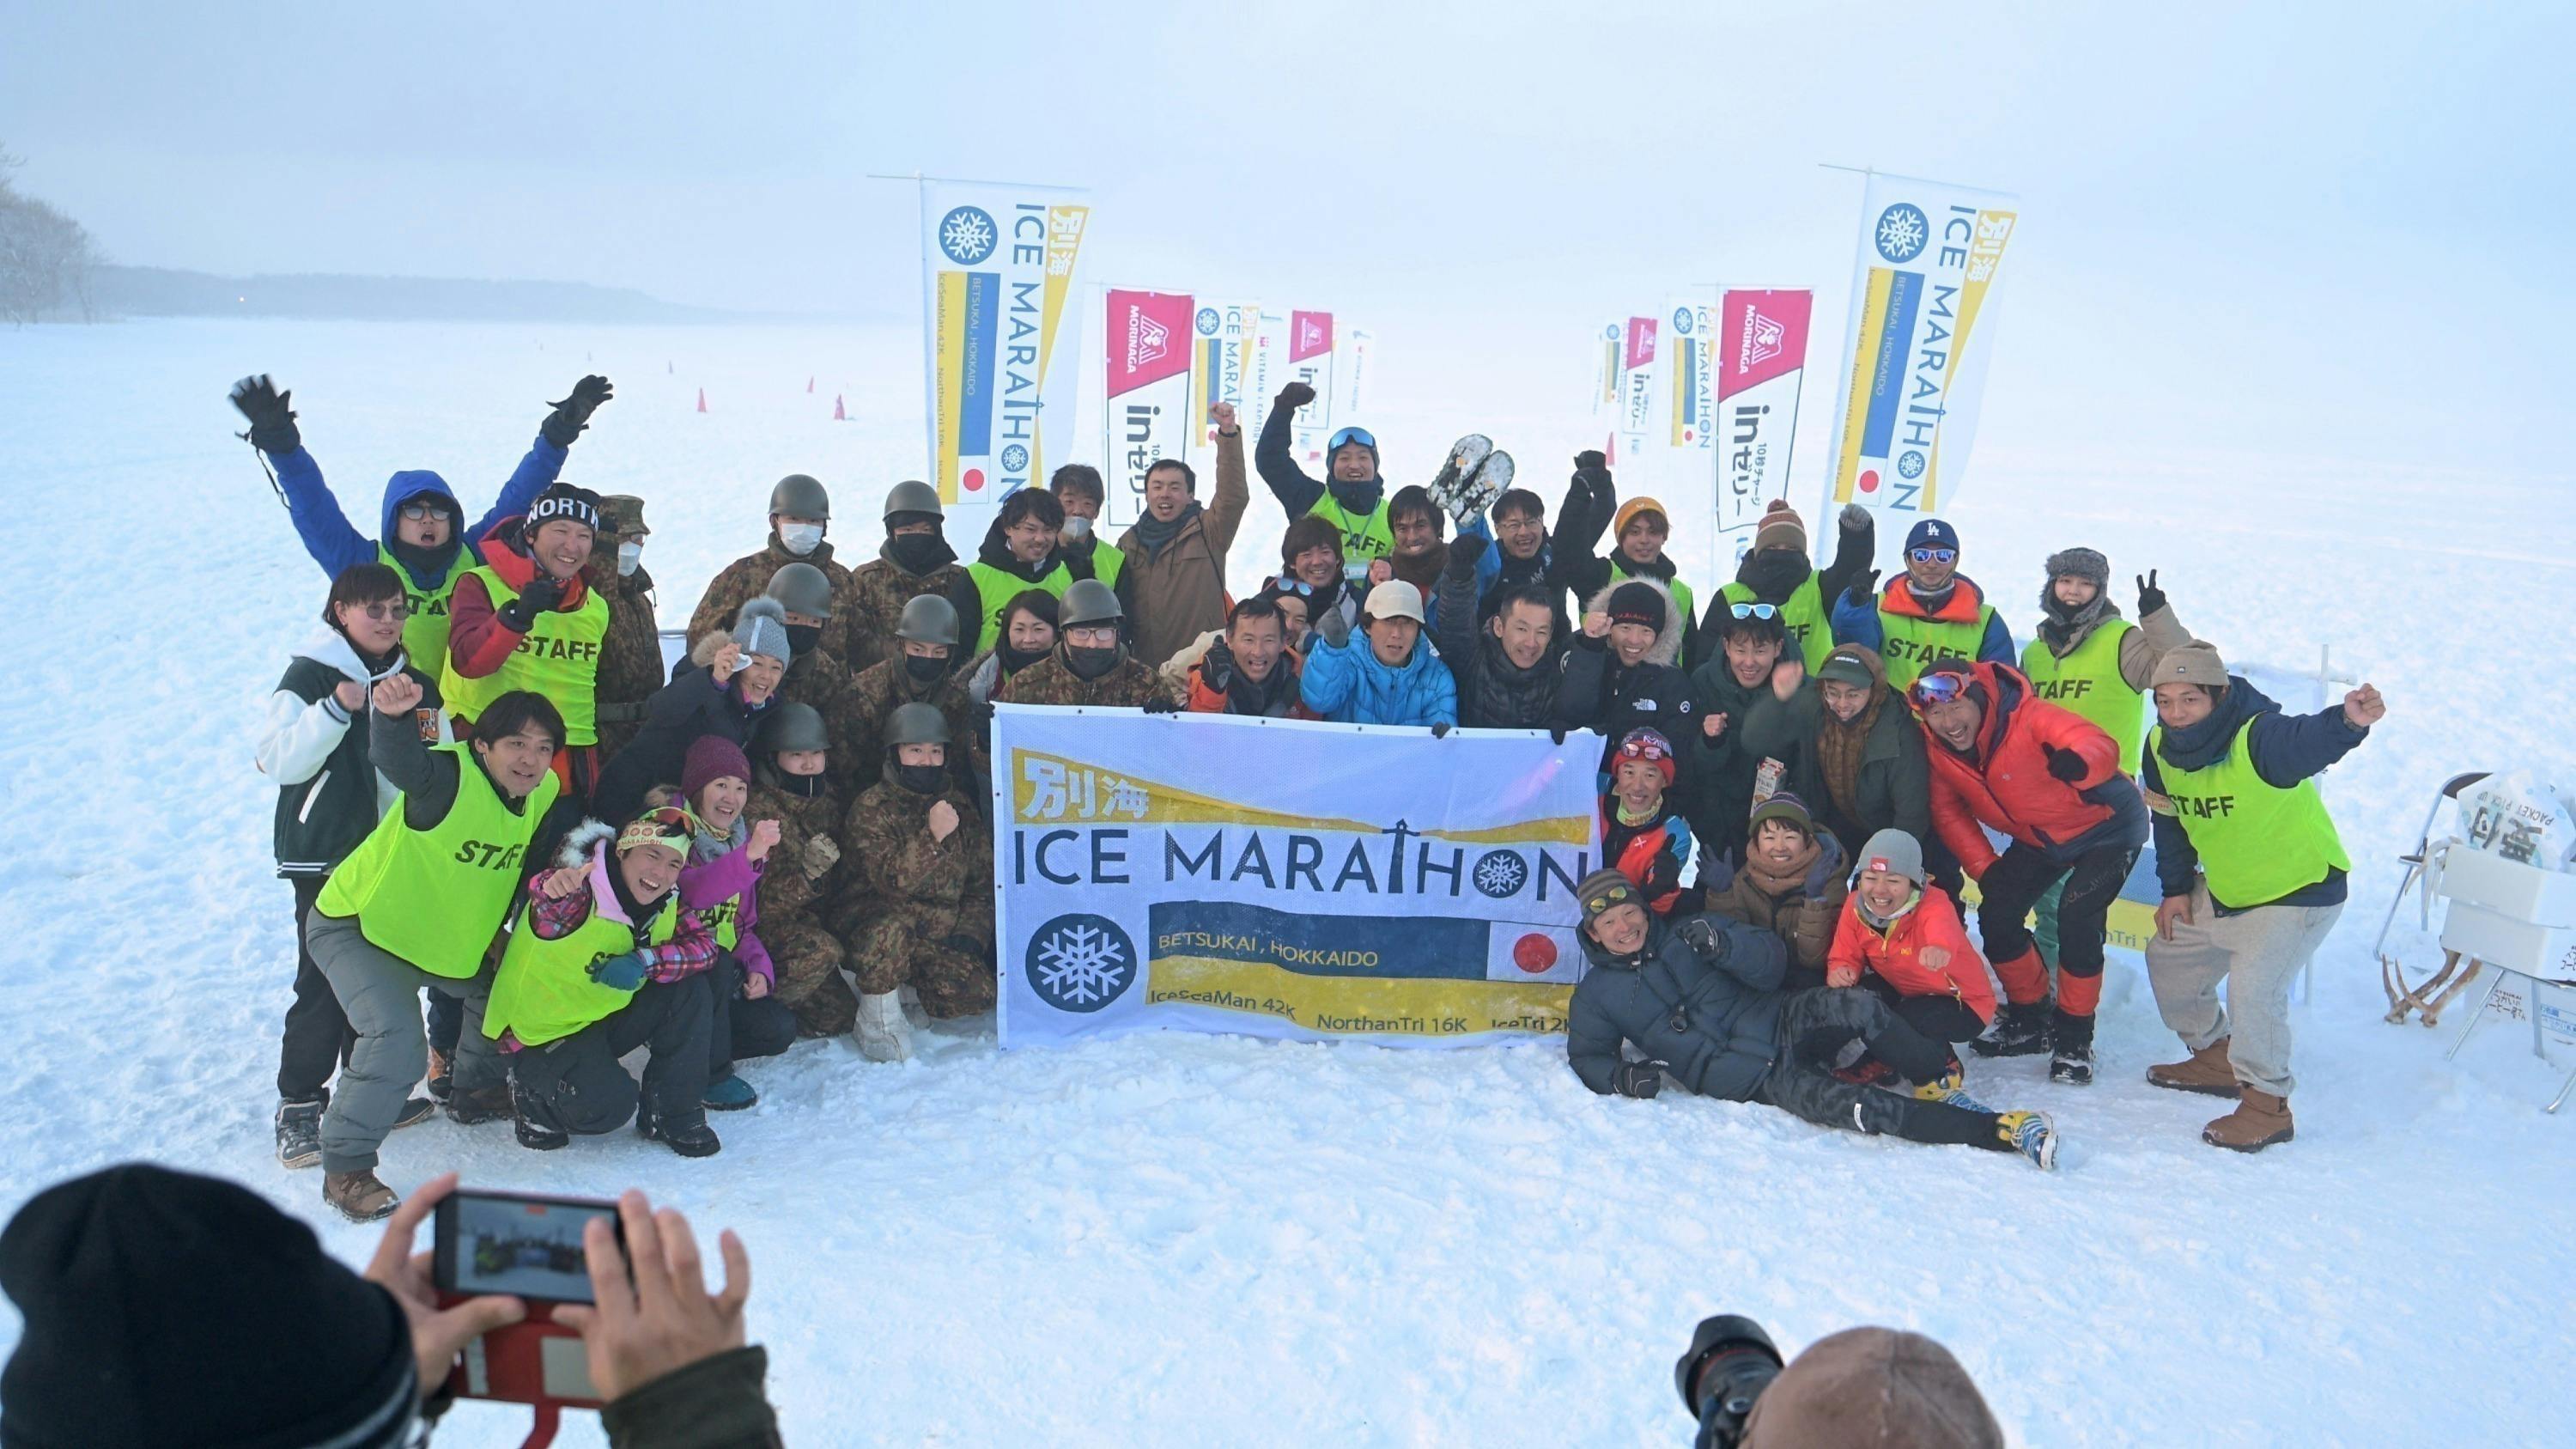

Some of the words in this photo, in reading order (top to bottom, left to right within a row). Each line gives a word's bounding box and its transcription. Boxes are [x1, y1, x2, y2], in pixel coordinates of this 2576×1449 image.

[1012, 204, 1046, 265] ICE
[1047, 209, 1084, 276] 別海
[1938, 205, 1977, 270] ICE
[1966, 214, 2013, 283] 別海
[1127, 305, 1140, 374] MORINAGA
[1226, 305, 1241, 335] ICE
[1697, 305, 1708, 335] ICE
[1739, 304, 1756, 375] MORINAGA
[966, 337, 978, 396] HOKKAIDO
[998, 283, 1044, 503] MARATHON
[1223, 343, 1243, 405] MARAT
[1698, 342, 1711, 448] MARATHON
[1876, 336, 1893, 397] HOKKAIDO
[1889, 284, 1959, 512] MARATHON
[1927, 522, 1940, 536] LA
[514, 635, 598, 661] STAFF
[2032, 679, 2093, 699] TAFF
[1021, 757, 1149, 819] 別海
[2517, 804, 2555, 826] PACKET
[1015, 828, 1129, 885] ICE
[1164, 819, 1588, 901] MARATHON
[2469, 807, 2543, 864] 受付
[1270, 941, 1378, 967] HOKKAIDO
[1261, 998, 1297, 1021] 42K
[1317, 1014, 1425, 1032] NorthanTri
[1431, 1017, 1467, 1032] 16K
